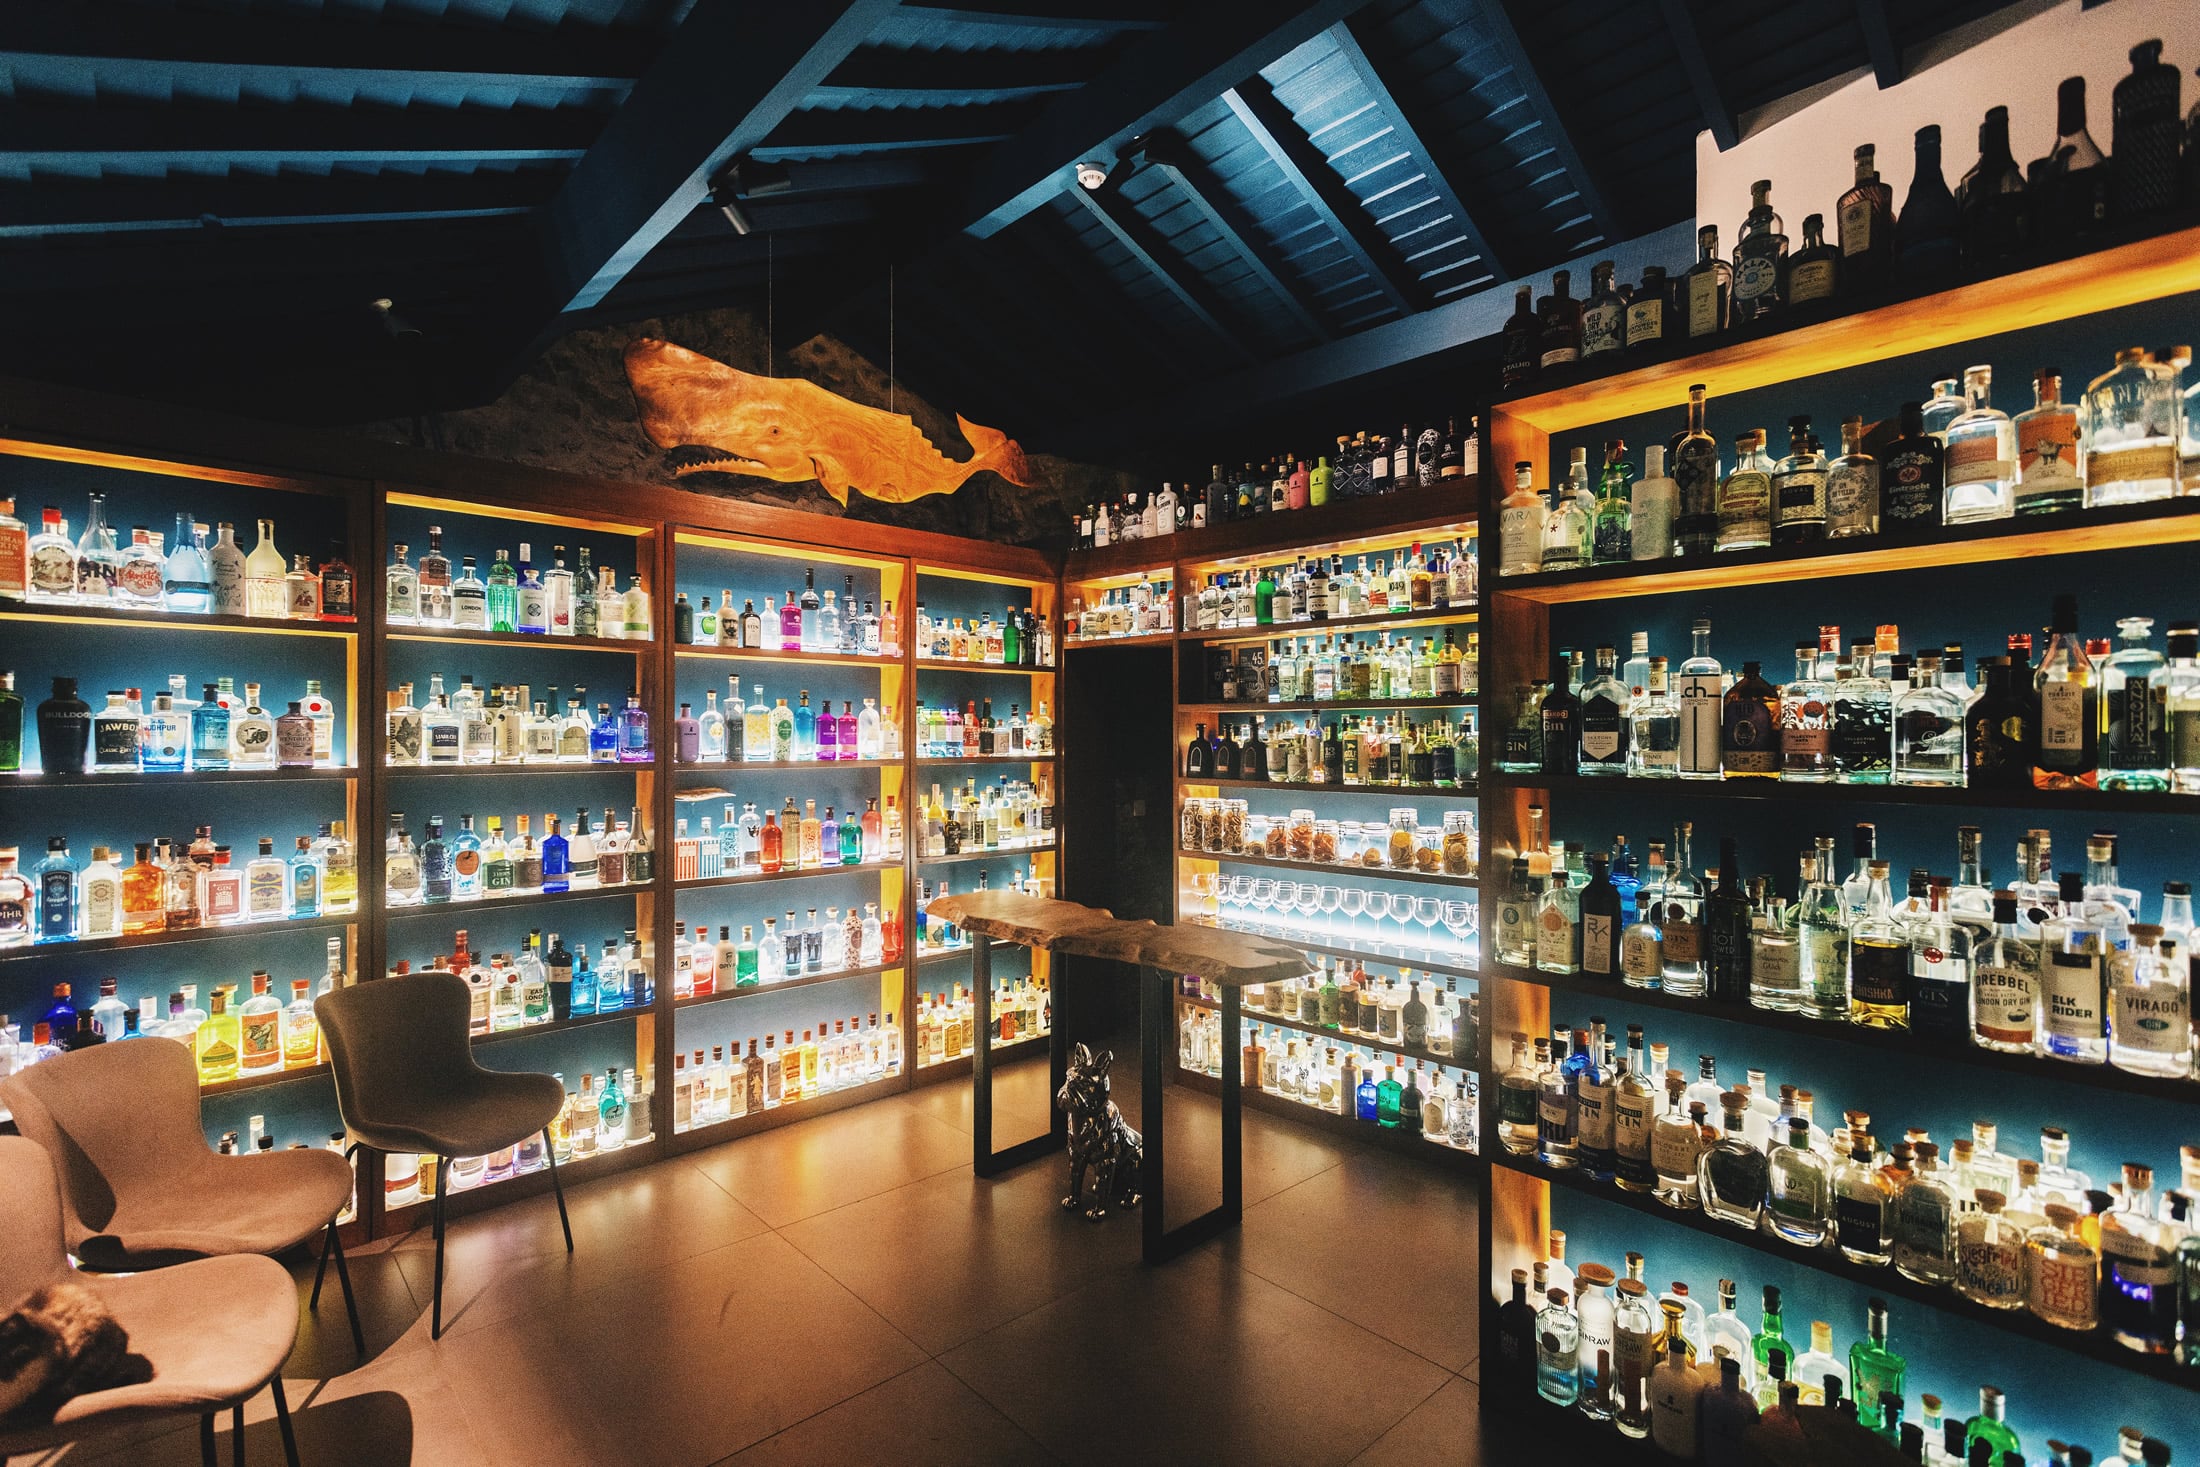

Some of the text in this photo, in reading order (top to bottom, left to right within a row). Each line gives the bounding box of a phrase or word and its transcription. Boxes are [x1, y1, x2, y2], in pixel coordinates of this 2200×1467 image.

[1505, 741, 1528, 752] GIN
[2003, 999, 2016, 1007] DRY
[2053, 995, 2076, 1007] ELK
[2126, 997, 2179, 1014] VIRAGO
[2053, 1005, 2093, 1018] RIDER
[1616, 1113, 1641, 1129] GIN
